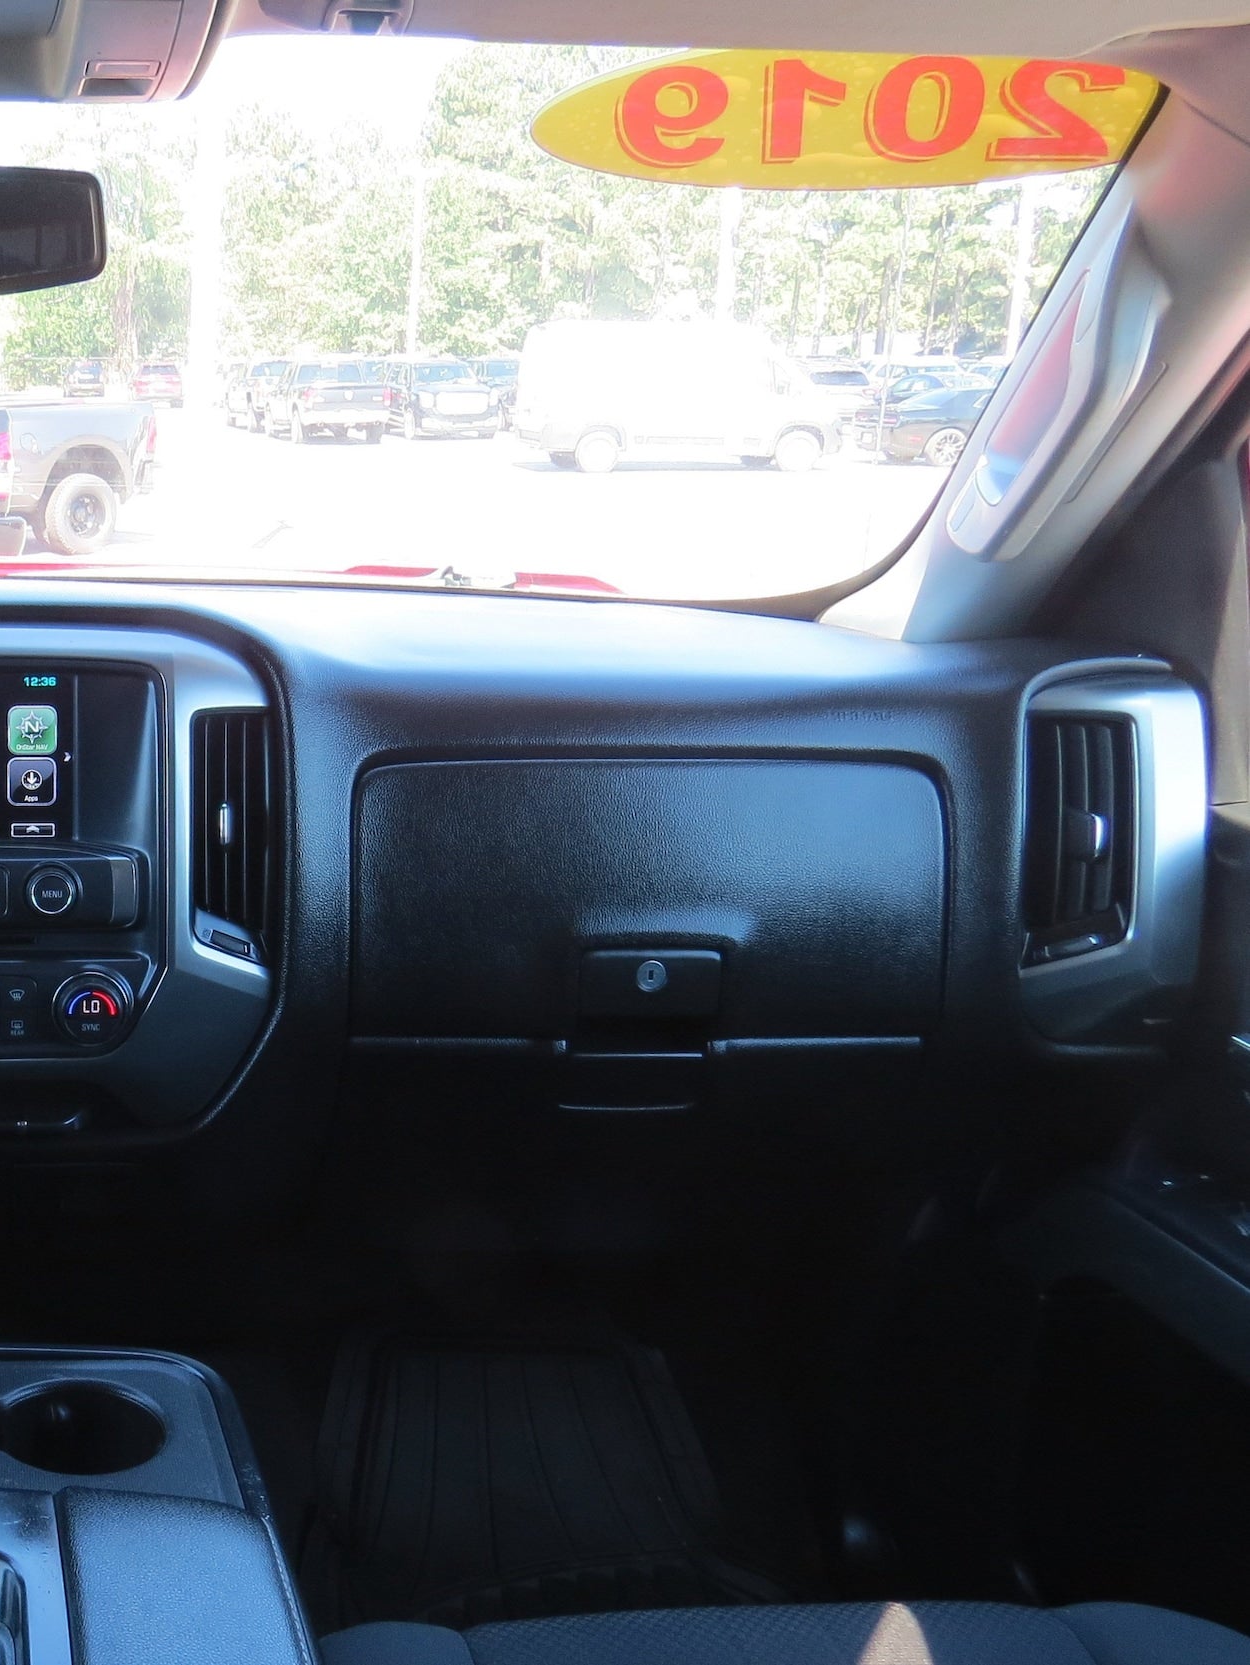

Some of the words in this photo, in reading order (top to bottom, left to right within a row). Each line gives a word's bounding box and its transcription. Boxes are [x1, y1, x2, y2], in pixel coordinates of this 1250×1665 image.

[23, 676, 57, 688] 12:36
[15, 743, 35, 751] OnStar
[35, 743, 49, 751] NAV
[23, 795, 39, 803] Apps
[41, 890, 63, 899] MENU
[82, 1000, 101, 1014] LO
[81, 1023, 101, 1032] SYNC
